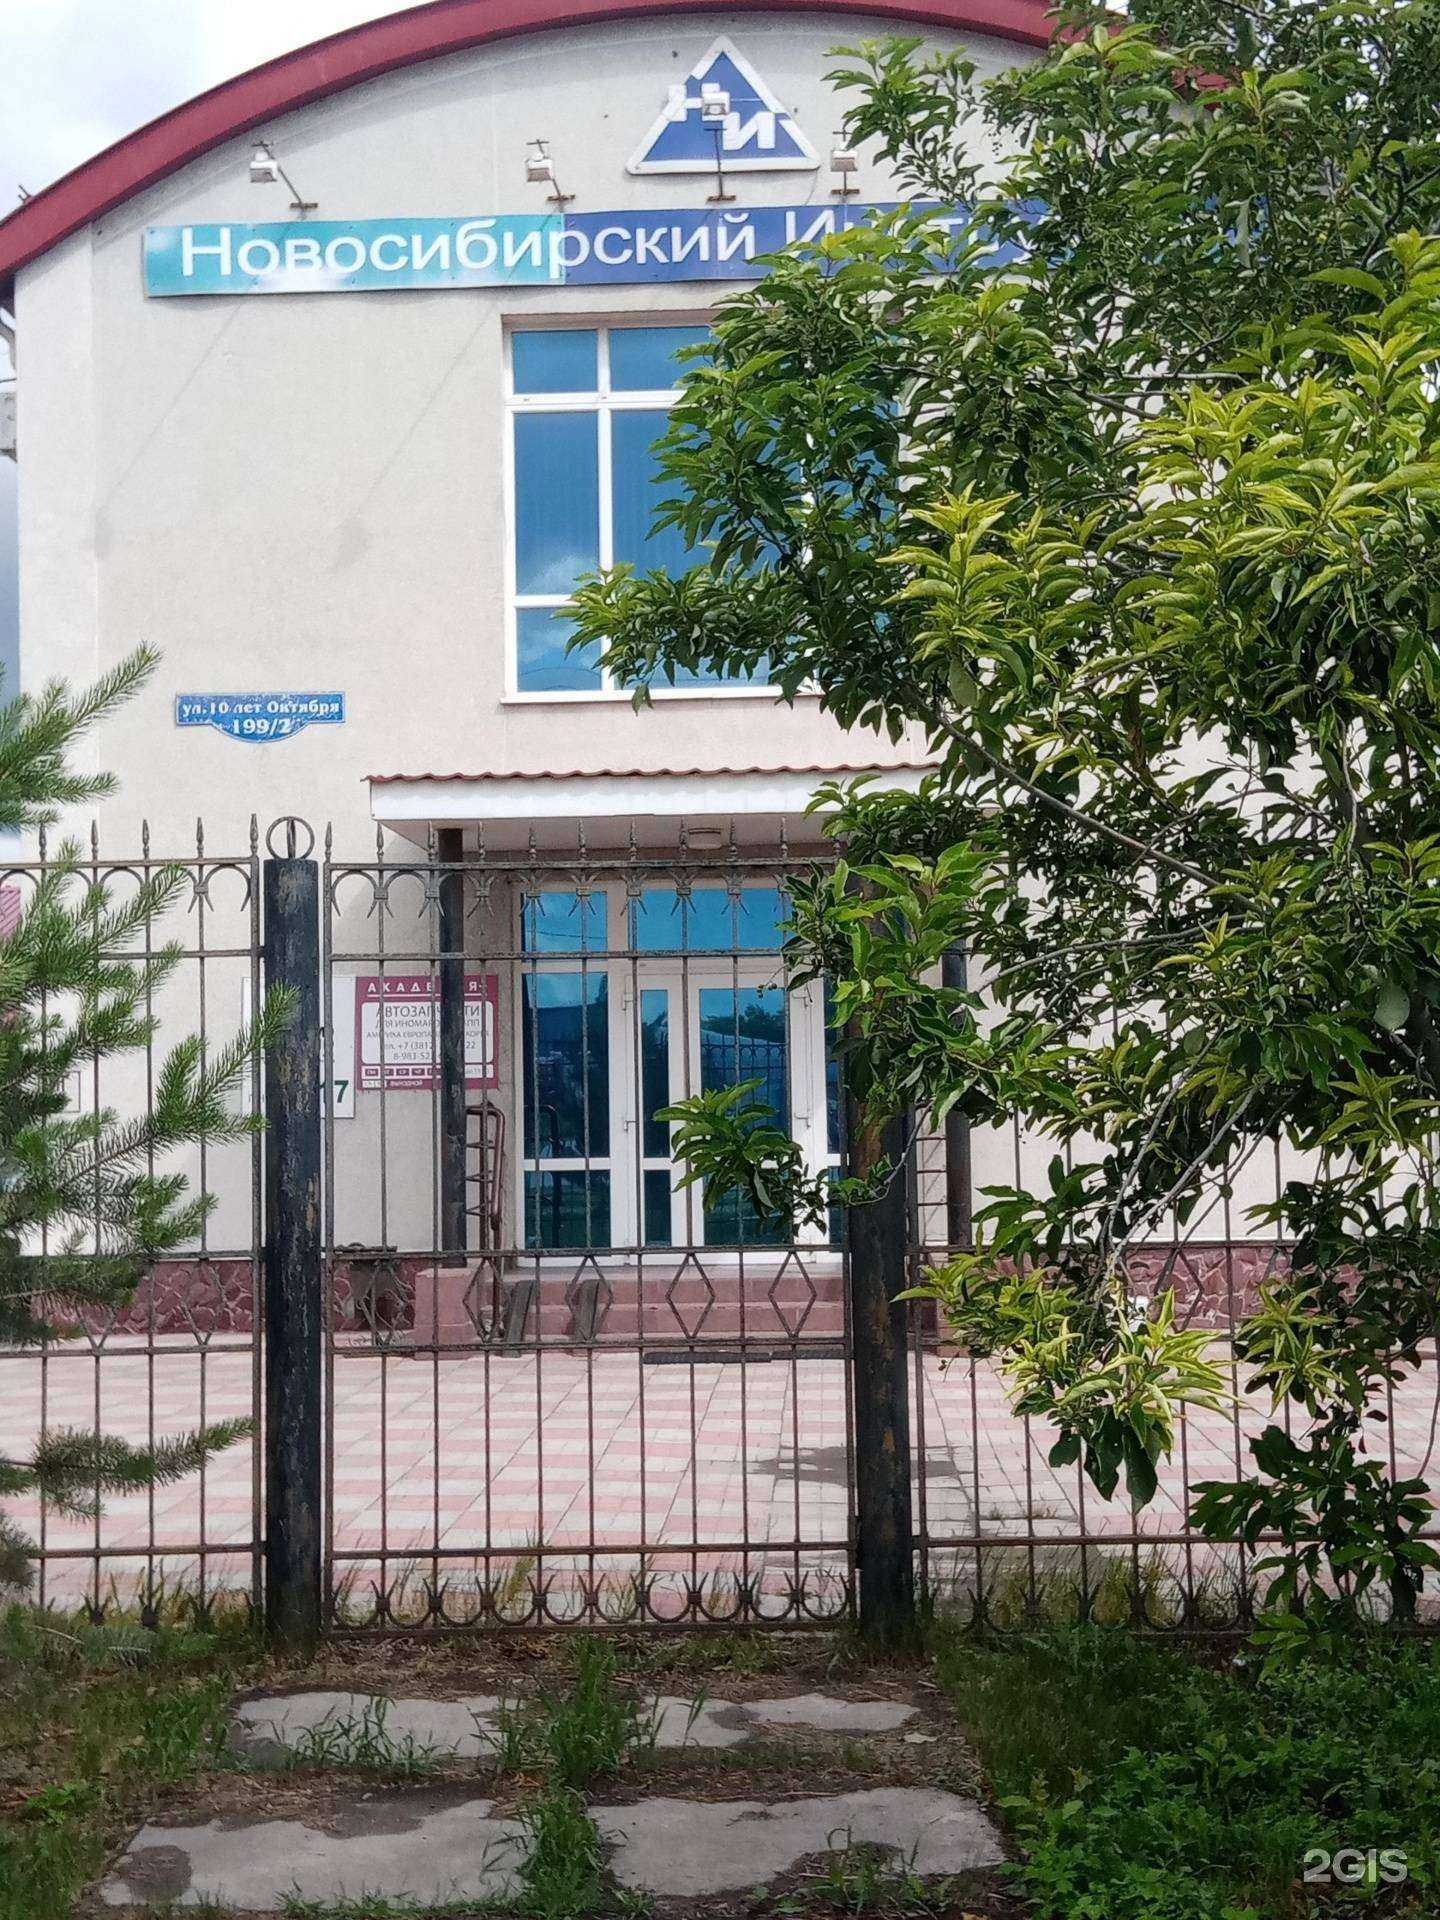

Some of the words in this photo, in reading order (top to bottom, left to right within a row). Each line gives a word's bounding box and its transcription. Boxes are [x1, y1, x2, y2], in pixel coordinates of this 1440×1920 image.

[181, 211, 757, 281] Новосибирский
[182, 703, 207, 717] ул.
[210, 702, 229, 714] 10
[233, 702, 261, 714] лет
[266, 699, 340, 717] Октября
[232, 718, 291, 735] 199/2
